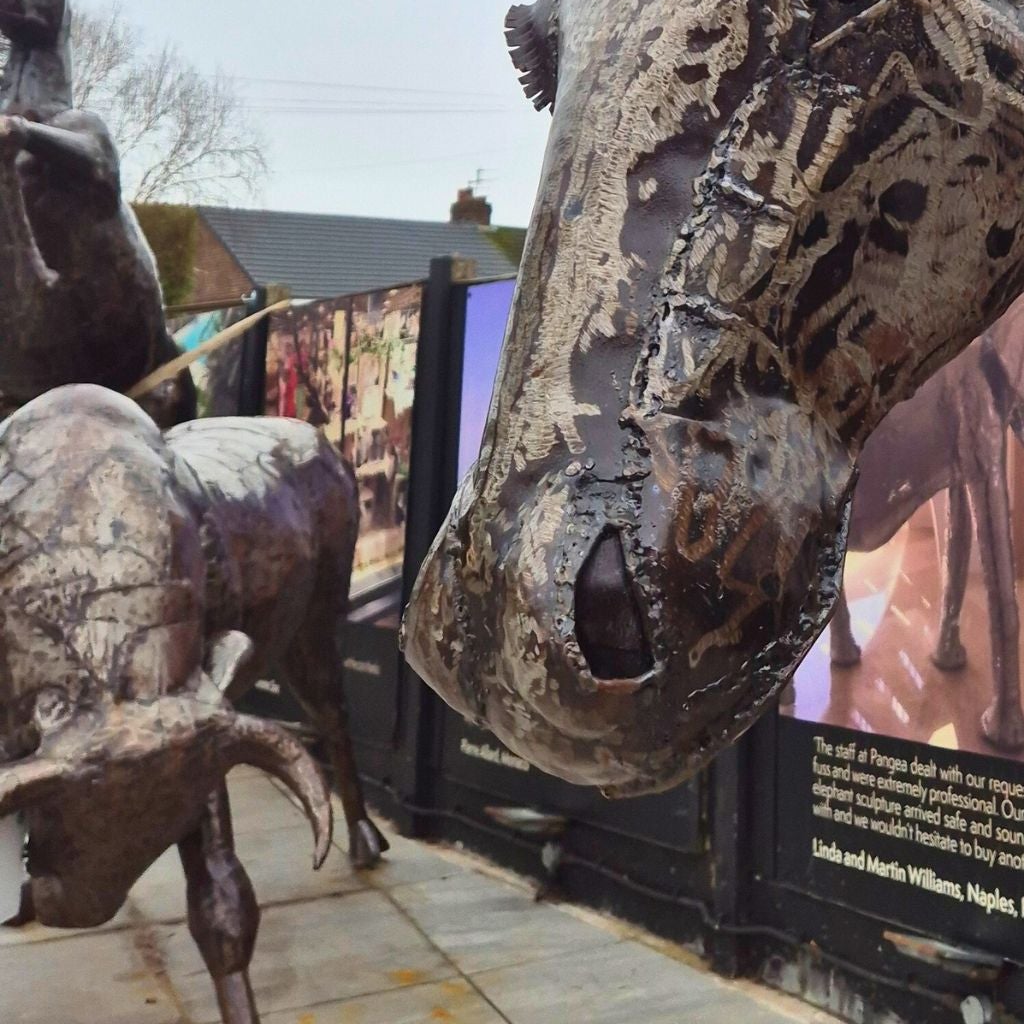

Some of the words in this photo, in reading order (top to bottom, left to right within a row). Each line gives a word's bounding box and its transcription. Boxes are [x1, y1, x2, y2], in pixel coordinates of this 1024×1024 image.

[812, 755, 831, 776] fuss
[832, 762, 850, 781] and
[852, 771, 876, 787] were
[877, 775, 927, 803] extremely
[1001, 799, 1024, 821] Our
[813, 736, 833, 756] The
[835, 741, 856, 760] staff
[858, 748, 868, 764] at
[870, 748, 907, 774] Pangea
[910, 755, 937, 778] dealt
[940, 764, 963, 783] with
[966, 772, 985, 789] our
[812, 778, 854, 805] elephant
[856, 790, 901, 814] sculpture
[904, 804, 941, 825] arrived
[943, 810, 967, 831] safe
[970, 818, 992, 838] and
[812, 802, 832, 819] with
[834, 806, 852, 824] and
[854, 815, 868, 829] we
[870, 816, 913, 840] wouldn't
[915, 823, 958, 852] hesitate
[960, 838, 971, 856] to
[974, 839, 996, 868] buy
[812, 837, 842, 864] Linda
[844, 848, 865, 871] and
[867, 853, 906, 882] Martin
[908, 864, 964, 902] Williams,
[967, 882, 1018, 918] Naples,
